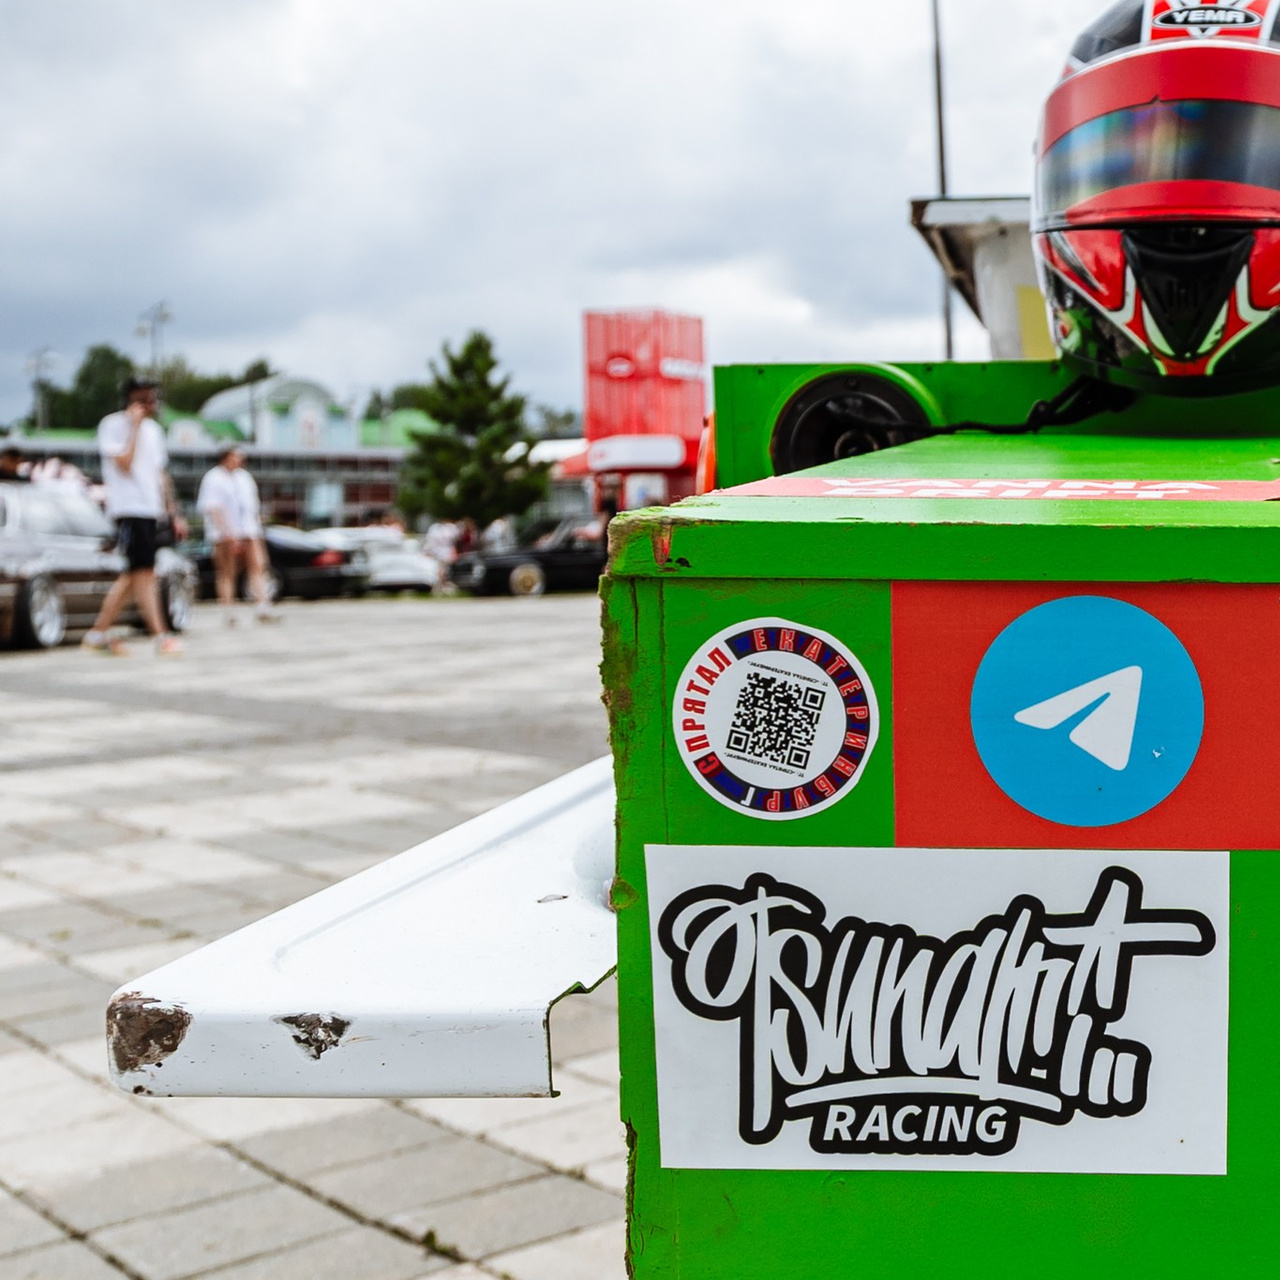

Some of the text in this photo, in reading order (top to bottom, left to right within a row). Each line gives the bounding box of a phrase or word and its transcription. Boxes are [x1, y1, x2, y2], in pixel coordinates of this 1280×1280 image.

[1172, 9, 1246, 24] YEMA
[821, 478, 1221, 490] VANNA
[820, 487, 1190, 499] DRIFT
[740, 628, 869, 812] ЕКАТЕРИНБУРГ
[823, 1104, 1007, 1143] RACING
